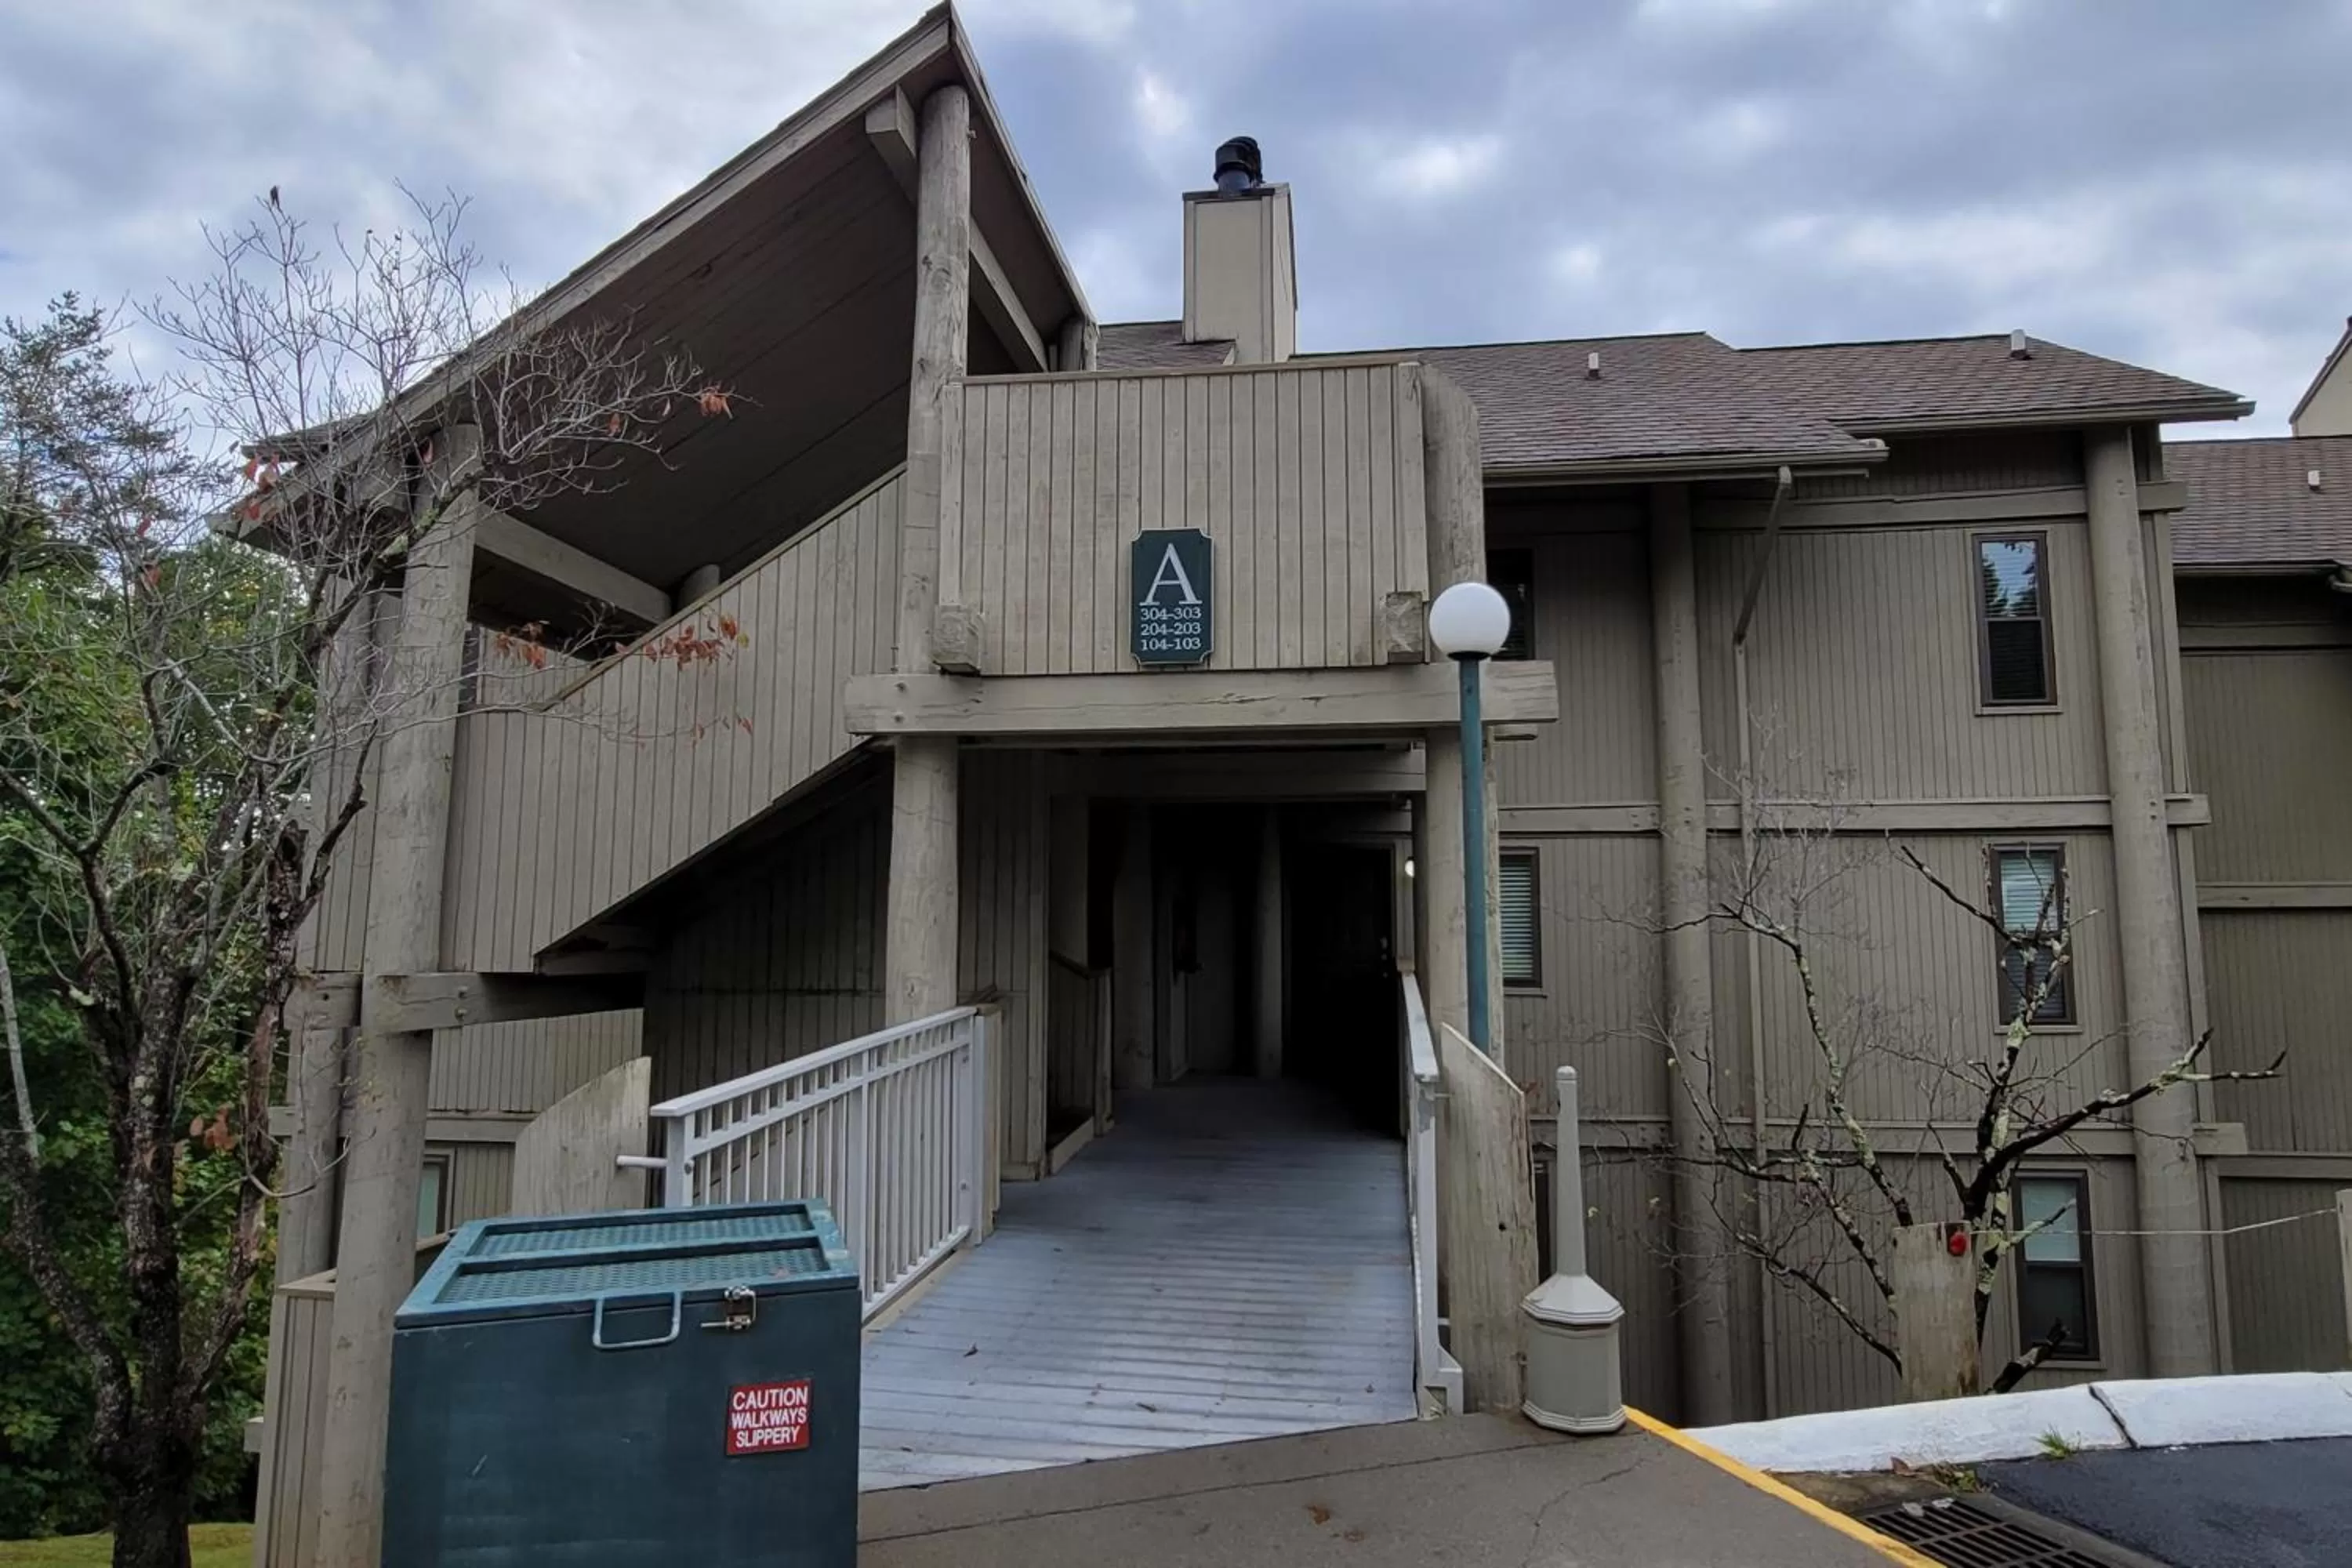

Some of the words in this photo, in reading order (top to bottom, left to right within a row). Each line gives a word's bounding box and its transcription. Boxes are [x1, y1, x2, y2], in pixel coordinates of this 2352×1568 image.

[1139, 543, 1203, 606] A
[1140, 608, 1202, 620] 304-303
[1141, 622, 1202, 636] 204-203
[1141, 637, 1202, 651] 104-103
[732, 1385, 808, 1410] CAUTION
[731, 1406, 807, 1430] WALKWAYS
[735, 1425, 800, 1448] SLIPPERY
